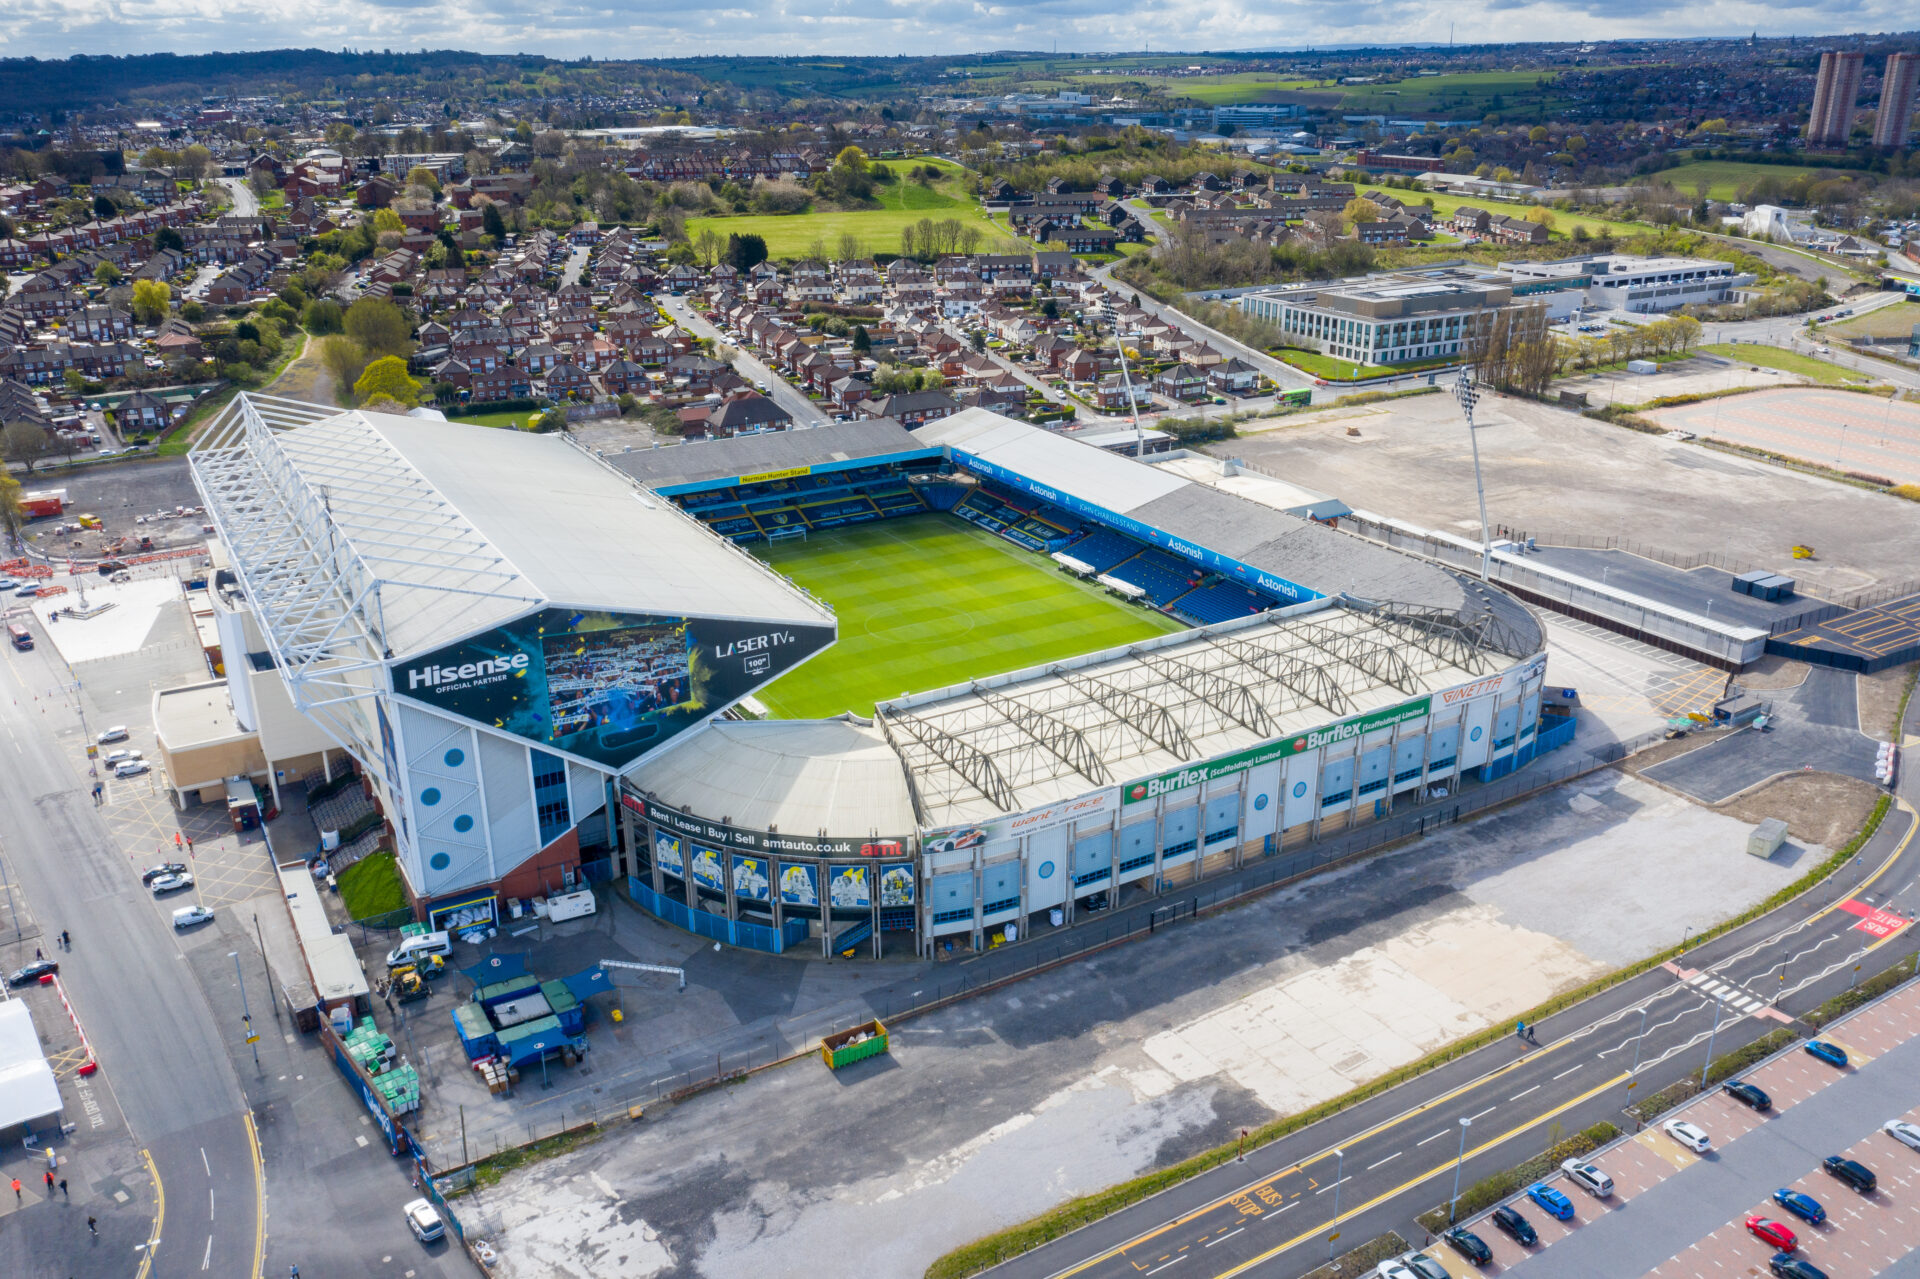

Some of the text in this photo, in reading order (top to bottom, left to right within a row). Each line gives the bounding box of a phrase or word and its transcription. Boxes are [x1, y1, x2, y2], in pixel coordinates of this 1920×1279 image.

[742, 468, 808, 483] Norman Hunter Stand
[968, 458, 993, 475] Astonish
[1029, 482, 1057, 501] Astonish
[1079, 503, 1140, 533] JOHN CHARLES STAND
[1167, 537, 1203, 560] Astonish
[1257, 573, 1298, 598] Astonish
[715, 630, 789, 658] LASER TV
[408, 653, 529, 690] Hisense
[435, 674, 508, 694] OFFICIAL PARTNER
[1442, 676, 1504, 703] GINETTA
[1307, 721, 1361, 750] Burflex
[1401, 707, 1425, 720] Limited
[1147, 750, 1281, 798] Burflex (Scaffolding) Limited
[650, 807, 903, 857] Rent Lease Buy Sell amtauto.co.uk amt
[1863, 921, 1889, 935] BUS
[1872, 912, 1903, 928] GATE
[1230, 1195, 1263, 1216] STOP
[1254, 1186, 1282, 1205] BUS
